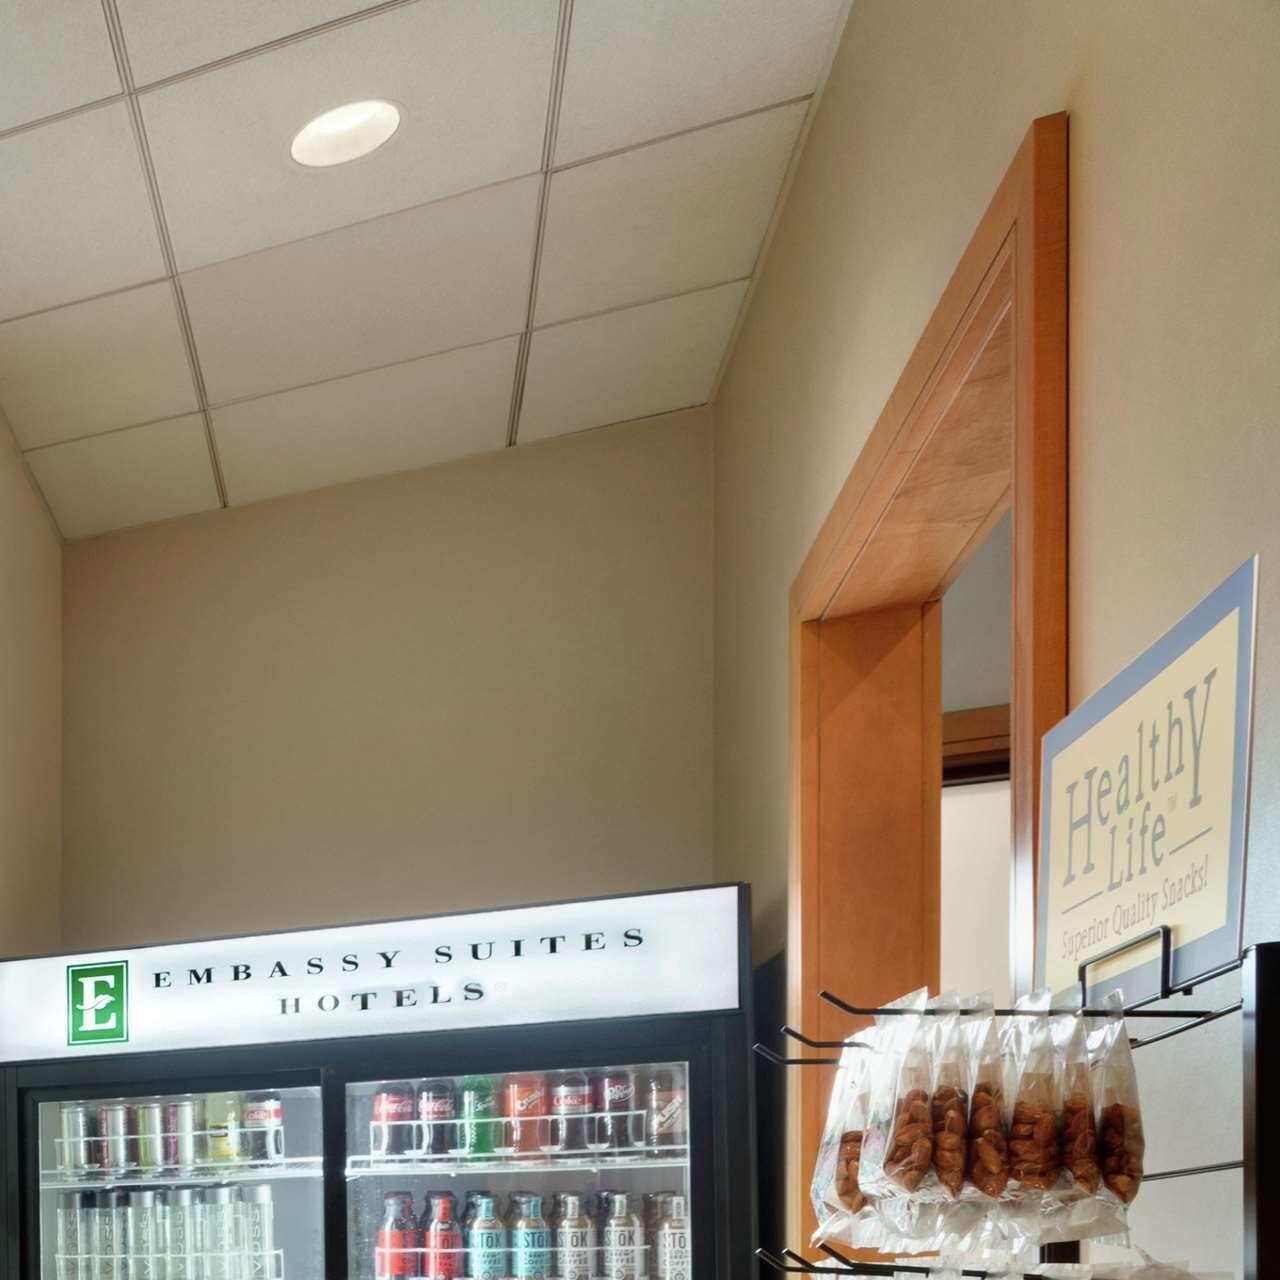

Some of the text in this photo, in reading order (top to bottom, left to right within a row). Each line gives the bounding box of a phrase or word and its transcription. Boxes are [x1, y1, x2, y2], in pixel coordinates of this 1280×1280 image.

[1107, 801, 1167, 892] Life
[1062, 854, 1209, 961] Superior Quality Snacks!
[153, 927, 648, 989] EMBASSY SUITES
[279, 982, 486, 1016] HOTELS
